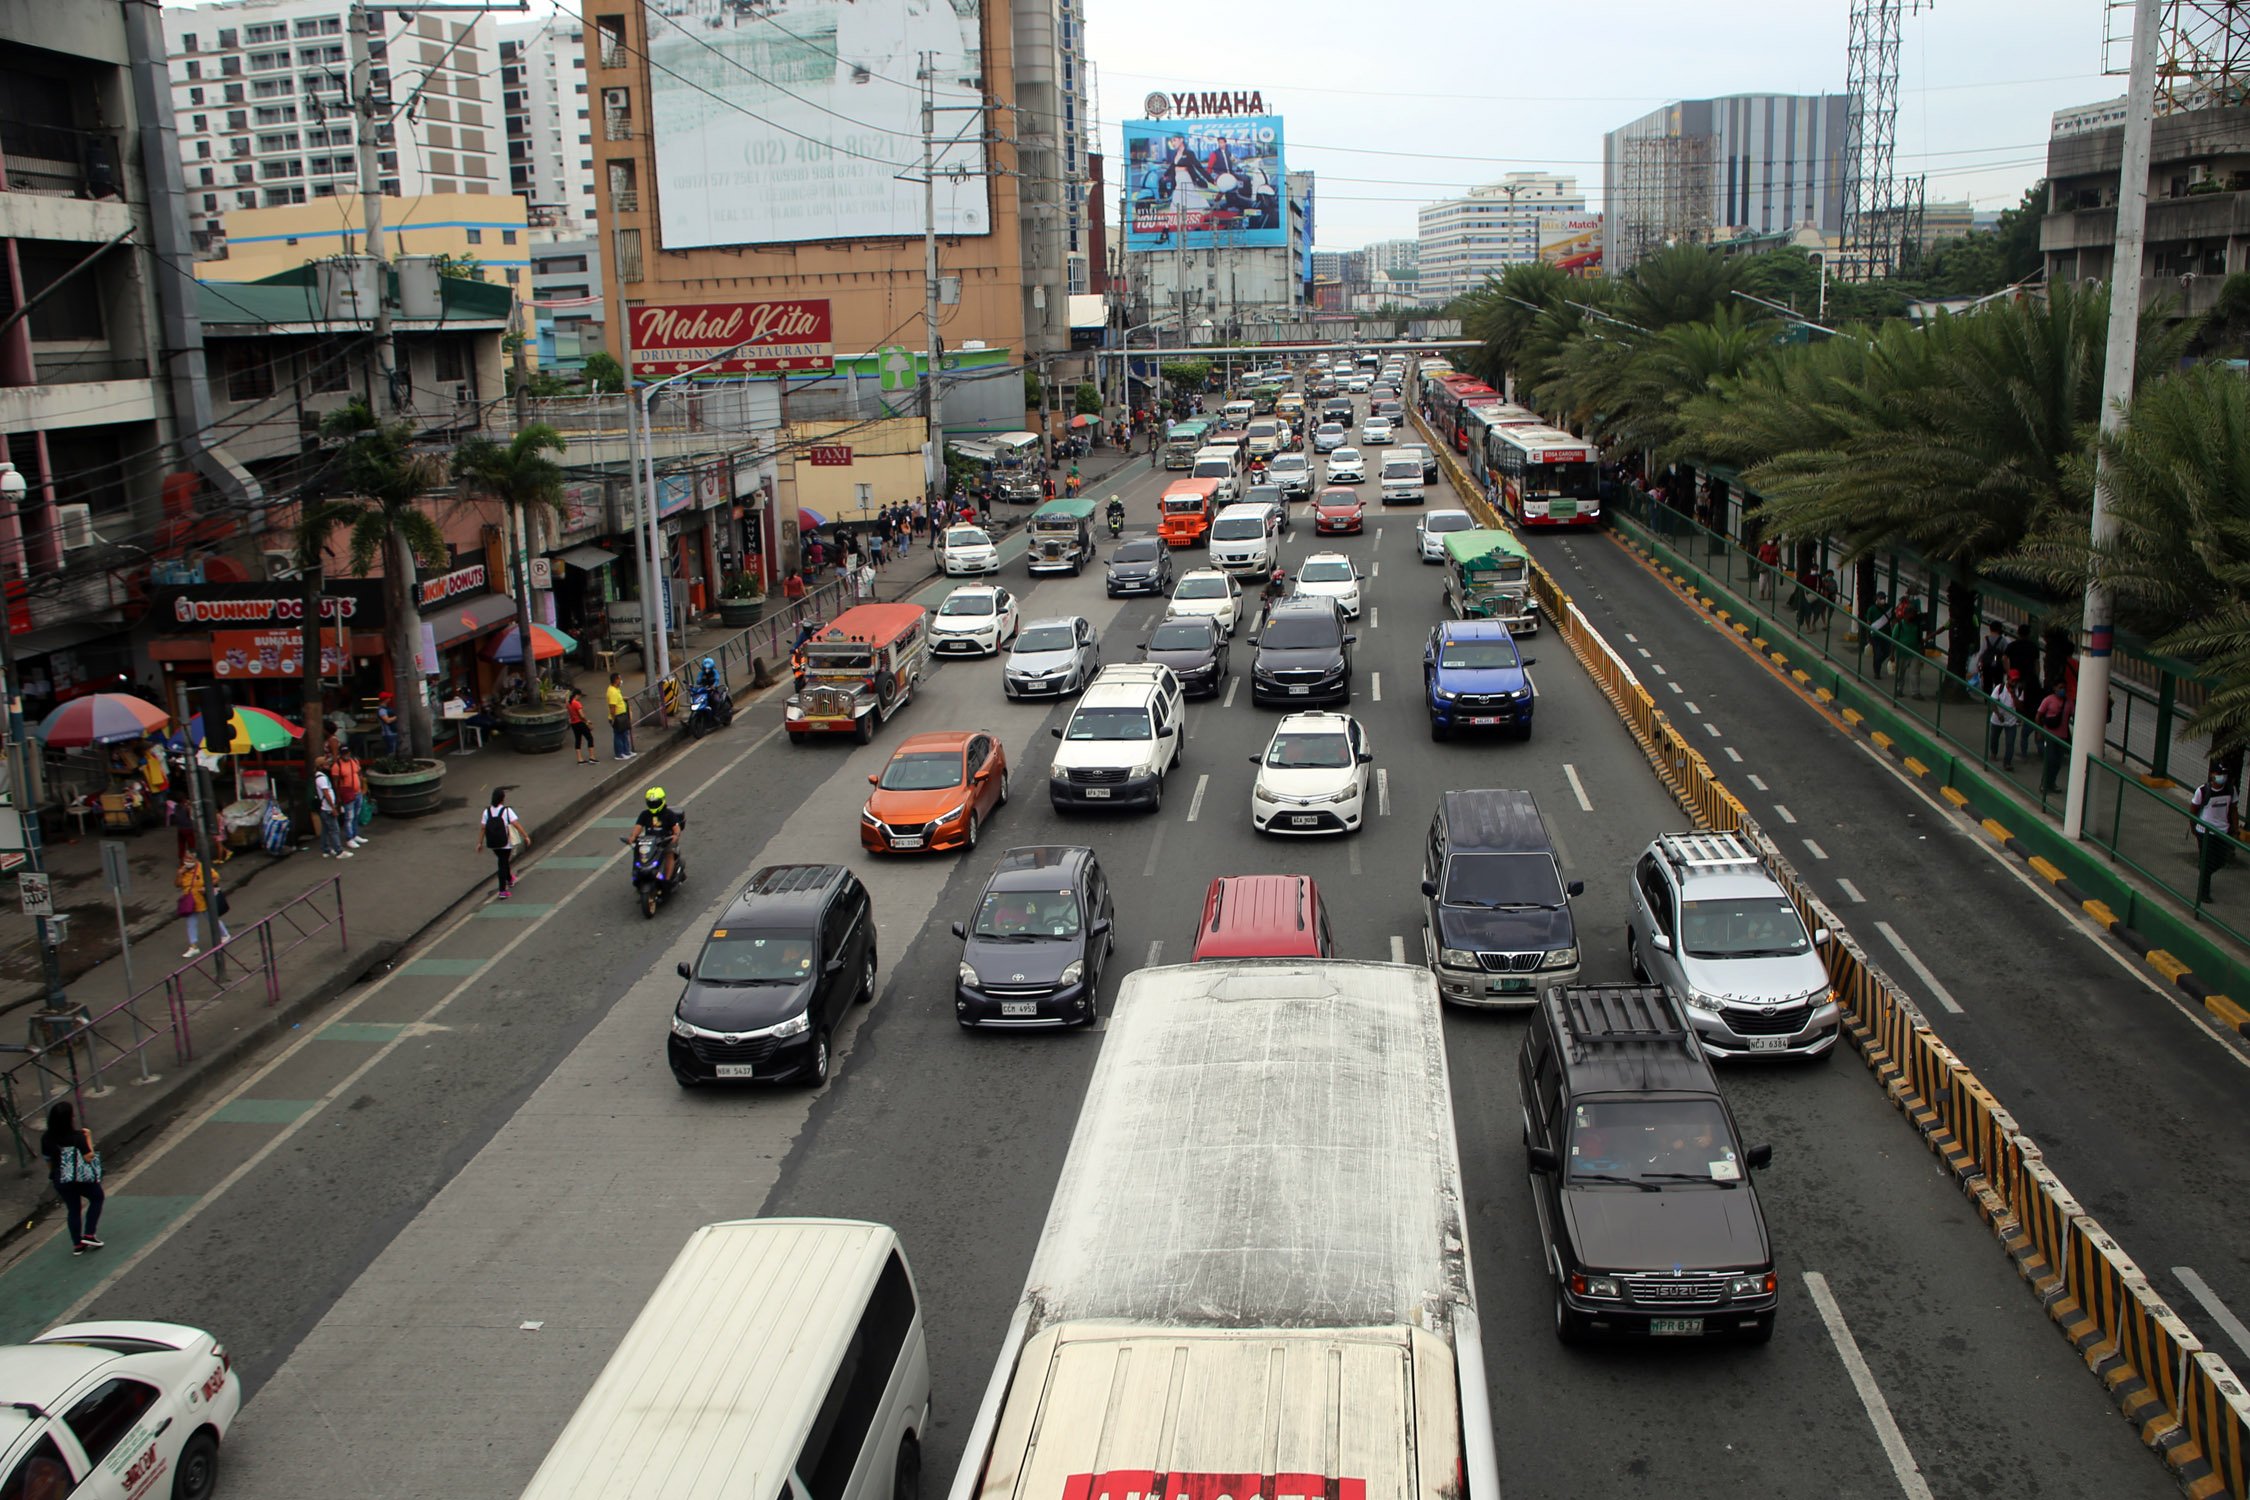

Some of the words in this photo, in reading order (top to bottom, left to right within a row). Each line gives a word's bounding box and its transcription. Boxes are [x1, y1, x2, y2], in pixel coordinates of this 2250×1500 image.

[1171, 91, 1264, 116] YAMAHA
[1568, 220, 1597, 229] Match
[639, 307, 744, 347] Mahal
[750, 303, 820, 342] Kita
[641, 348, 713, 361] DRIVE-INN
[816, 449, 847, 459] TAXI
[448, 564, 484, 596] DONUTS
[195, 600, 274, 620] DUNKIN'
[1722, 989, 1808, 1003] AVANZA
[1019, 1005, 1035, 1013] 4952
[1751, 1040, 1764, 1049] NCJ
[1769, 1039, 1787, 1048] 6384
[734, 1067, 751, 1075] 5437
[1656, 1287, 1698, 1296] ISUZU
[1678, 1320, 1701, 1331] 837
